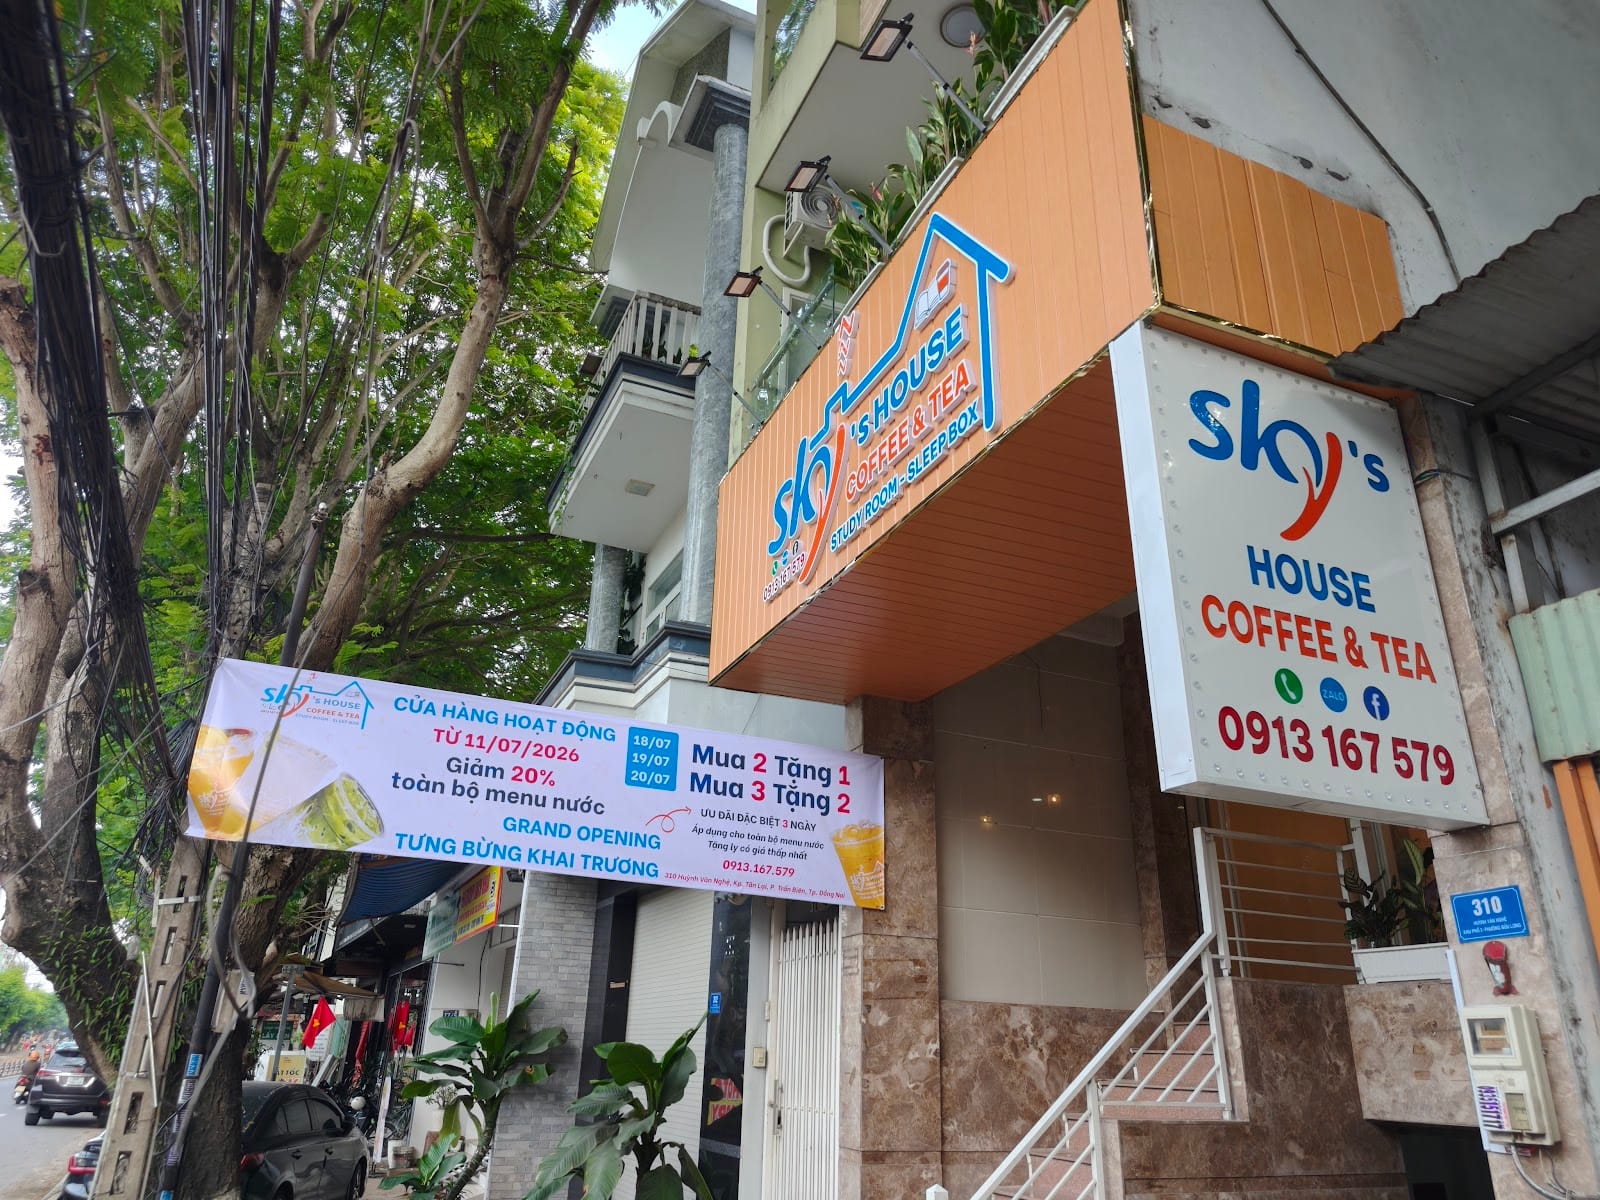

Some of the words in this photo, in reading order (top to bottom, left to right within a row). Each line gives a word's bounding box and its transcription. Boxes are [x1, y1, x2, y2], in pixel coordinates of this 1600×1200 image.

[873, 306, 964, 430] HOUSE
[846, 420, 909, 500] COFFEE
[912, 405, 925, 437] &
[929, 362, 970, 418] TEA
[831, 510, 863, 551] STUDY
[865, 477, 898, 517] ROOM
[907, 431, 947, 482] SLEEP
[949, 401, 978, 443] BOX
[792, 553, 805, 574] 579
[1247, 545, 1376, 613] HOUSE
[1201, 595, 1337, 663] COFFEE
[1345, 626, 1368, 669] &
[1371, 632, 1436, 684] TEA
[323, 698, 361, 710] HOUSE
[1322, 689, 1345, 702] ZALO
[306, 707, 335, 717] COFFEE
[394, 695, 436, 716] CỬA
[442, 702, 498, 725] HÀNG
[504, 713, 557, 735] HOẠT
[562, 720, 616, 742] ĐỘNG
[433, 726, 463, 744] TỪ
[464, 733, 579, 762] 11/07/2026
[633, 735, 671, 750] 18/07
[1218, 705, 1313, 763] 0913
[1322, 725, 1380, 774] 167
[1392, 739, 1455, 785] 579
[446, 756, 504, 780] Giảm
[511, 766, 556, 787] 20%
[632, 753, 670, 767] 19/07
[692, 743, 745, 770] Mua
[753, 752, 767, 773] 2
[774, 755, 832, 787] Tặng
[839, 765, 850, 786] 1
[392, 771, 445, 794] toàn
[451, 780, 479, 803] bộ
[485, 789, 547, 808] menu
[553, 794, 605, 815] nước
[631, 771, 670, 785] 20/07
[690, 772, 743, 799] Mua
[751, 780, 765, 802] 3
[772, 783, 830, 816] Tặng
[837, 793, 850, 814] 2
[503, 817, 572, 839] GRAND
[577, 826, 661, 850] OPENING
[700, 808, 716, 818] ƯU
[718, 810, 735, 821] ĐÃI
[737, 813, 757, 825] ĐẶC
[760, 817, 781, 829] BIỆT
[782, 820, 788, 828] 3
[790, 820, 816, 832] NGÀY
[692, 824, 704, 834] Áp
[705, 827, 728, 839] dụng
[729, 830, 745, 839] cho
[747, 832, 766, 842] toàn
[768, 835, 778, 845] bộ
[780, 838, 802, 847] menu
[804, 840, 825, 850] nước
[730, 842, 739, 853] ly
[740, 844, 750, 853] có
[752, 845, 766, 856] giá
[767, 846, 787, 860] thấp
[788, 850, 808, 860] nhất
[395, 832, 457, 855] TƯNG
[462, 837, 522, 862] BỪNG
[528, 849, 574, 868] KHAI
[581, 855, 659, 878] TRƯƠNG
[723, 860, 795, 877] 0913.167.579
[678, 873, 699, 882] Huỳnh
[1471, 895, 1502, 916] 310
